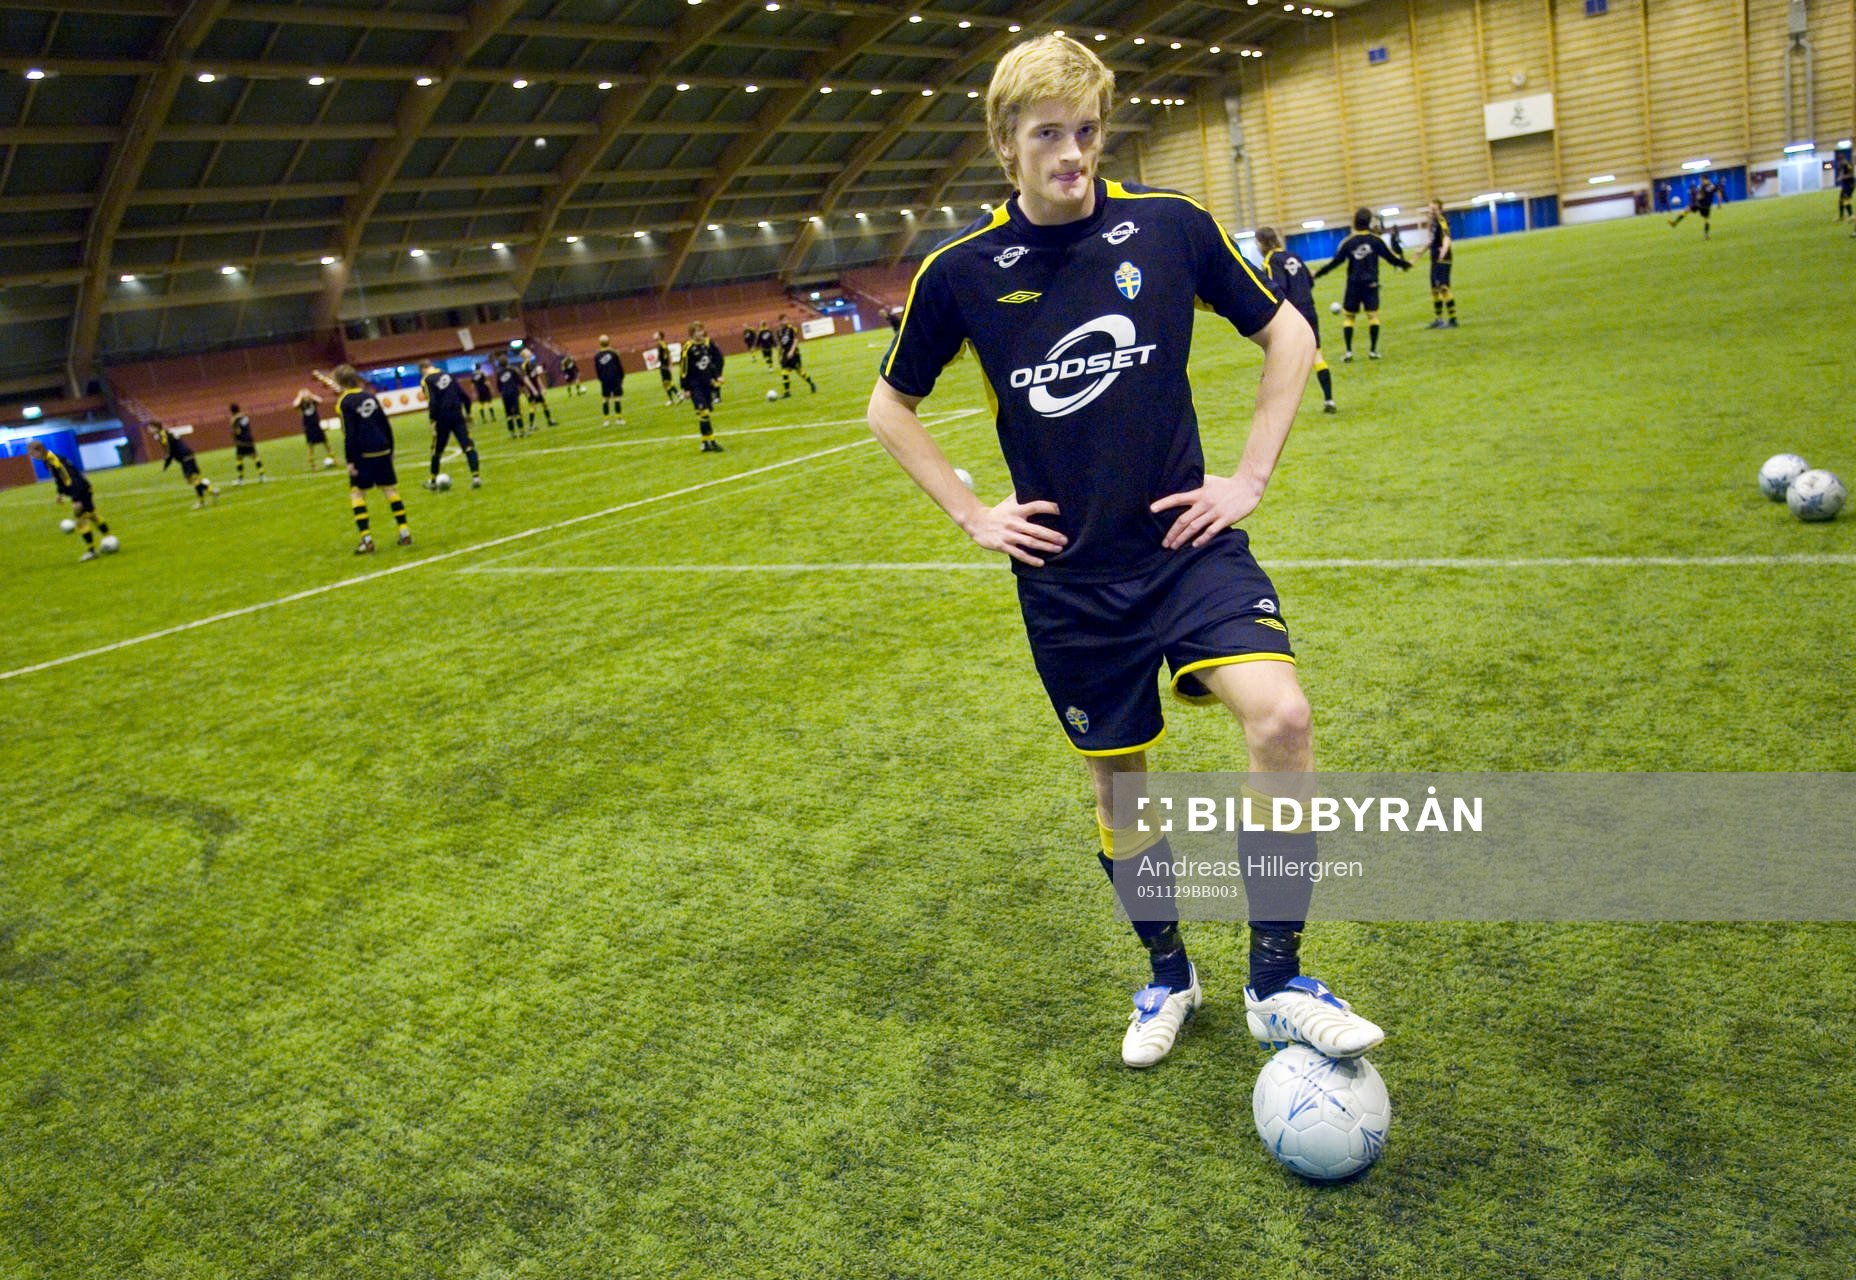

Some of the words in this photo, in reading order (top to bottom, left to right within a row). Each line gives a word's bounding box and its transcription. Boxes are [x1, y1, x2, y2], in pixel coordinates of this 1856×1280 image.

[1102, 227, 1140, 239] ODDSET
[993, 248, 1030, 263] ODDSET
[1010, 344, 1156, 388] ODDSET
